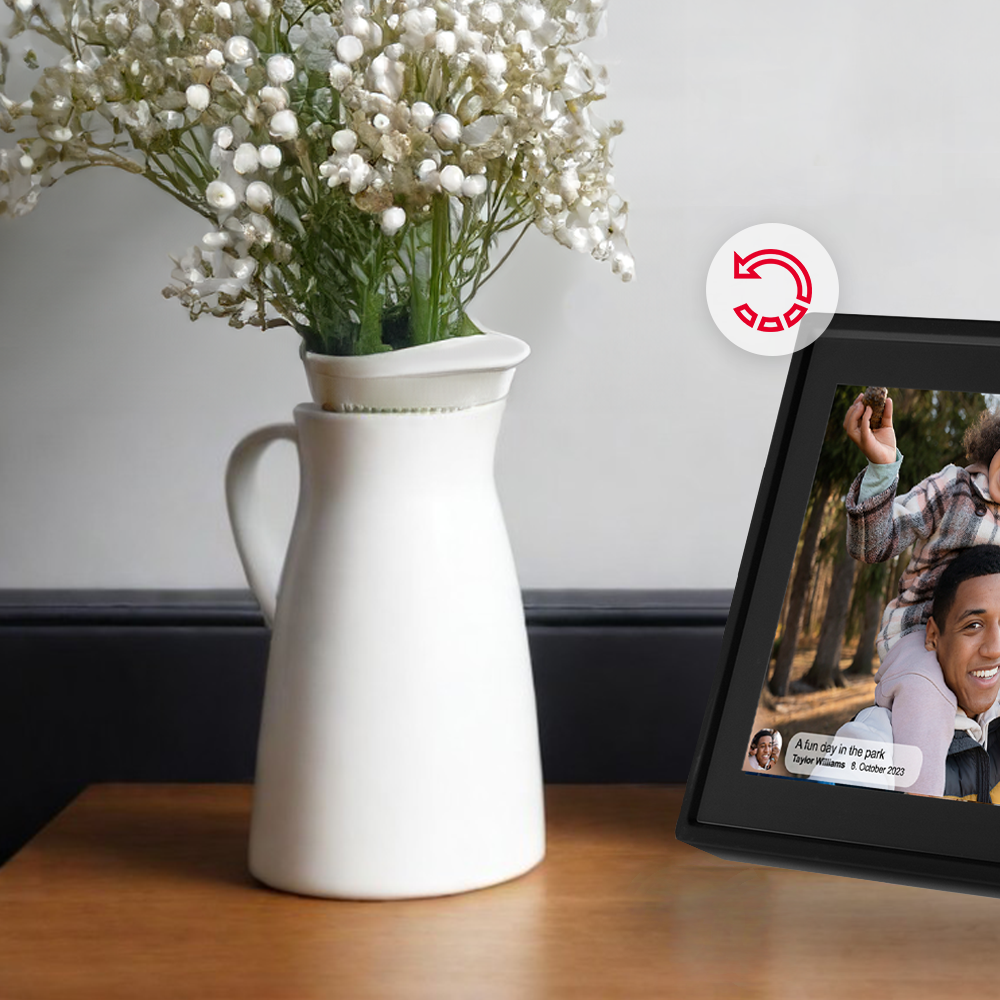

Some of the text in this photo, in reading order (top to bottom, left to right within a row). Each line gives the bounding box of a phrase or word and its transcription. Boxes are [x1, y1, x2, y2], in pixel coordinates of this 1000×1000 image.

[795, 738, 885, 760] A fun day in the park
[792, 754, 815, 766] Taylor
[815, 757, 846, 769] Williams
[859, 762, 887, 774] October
[887, 766, 906, 777] 2023
